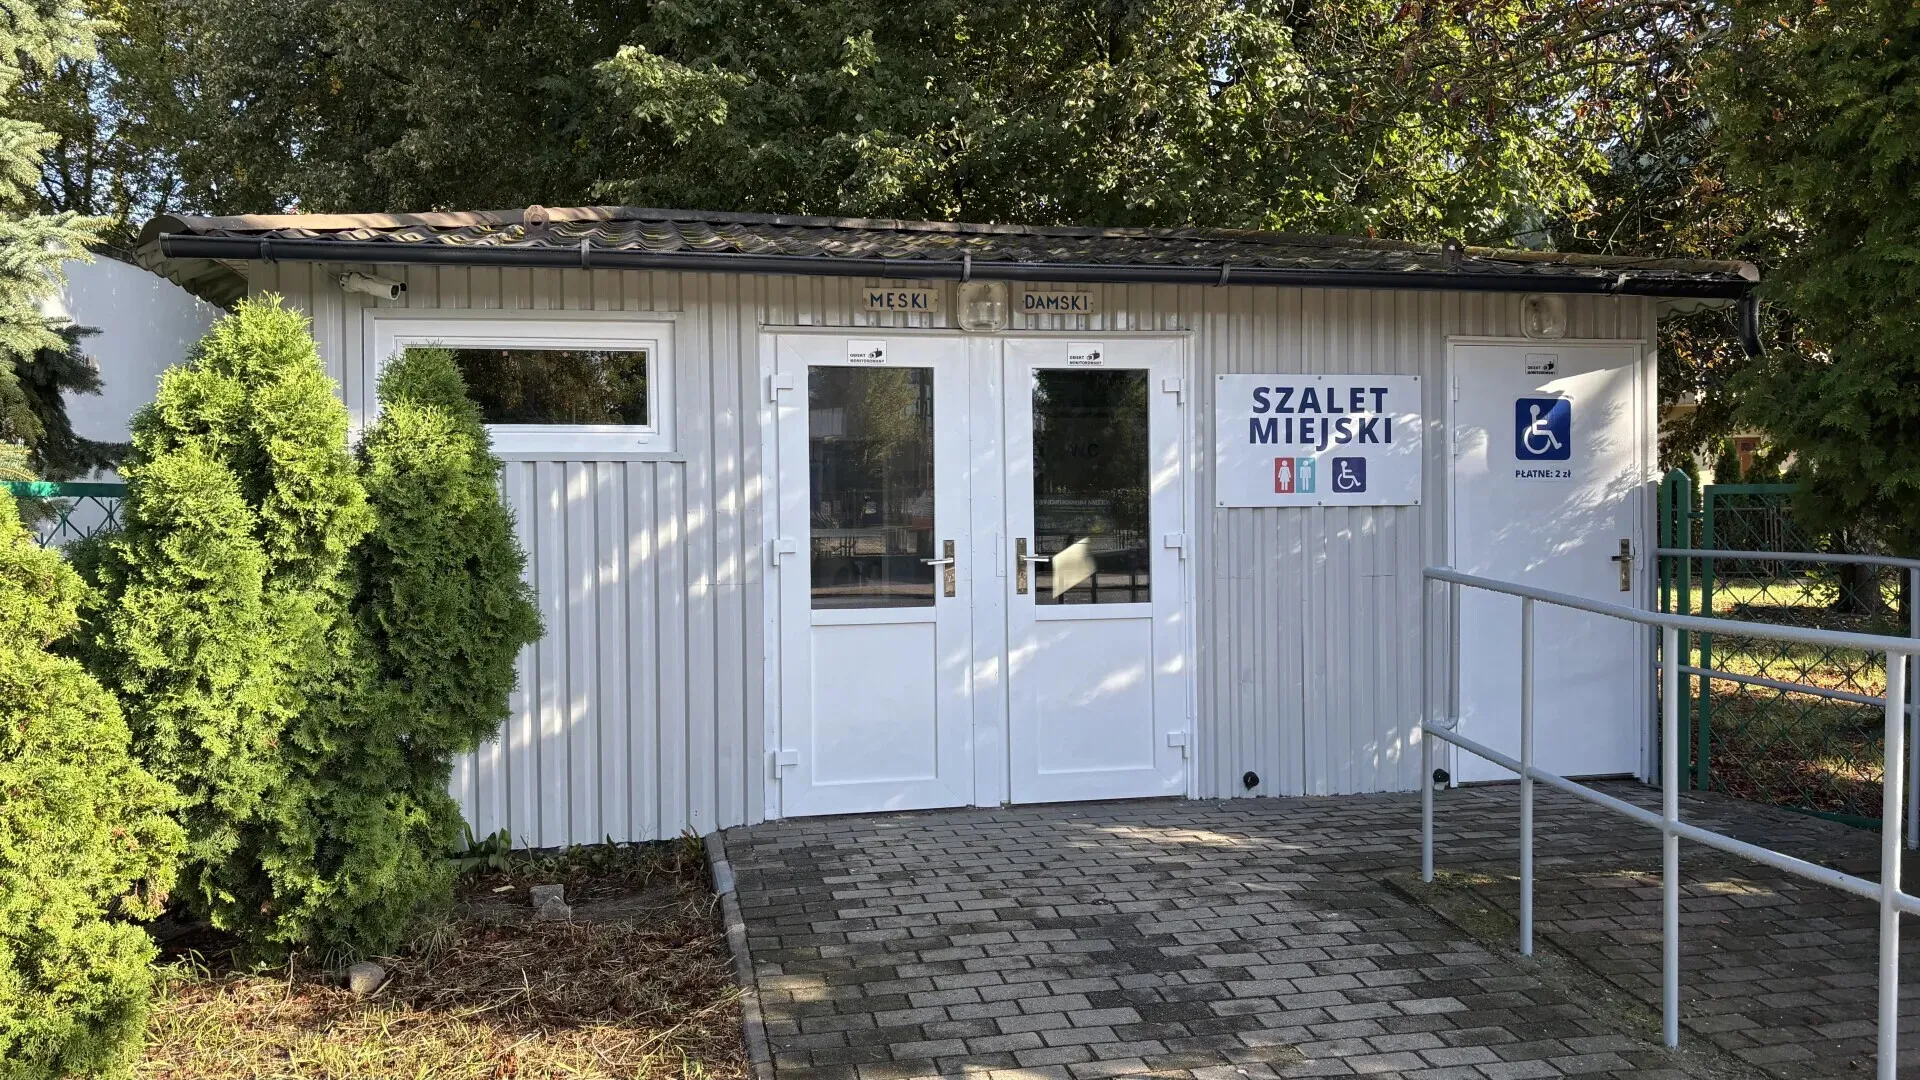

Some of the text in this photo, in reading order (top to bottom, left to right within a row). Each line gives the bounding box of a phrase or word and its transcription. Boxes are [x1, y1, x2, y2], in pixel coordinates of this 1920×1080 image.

[870, 292, 928, 310] MĘSKI
[1025, 294, 1088, 310] DAMSKI
[1252, 386, 1388, 414] SZALET
[1249, 417, 1392, 452] MIEJSKI
[1515, 469, 1571, 478] PŁATNE: 2 zł
